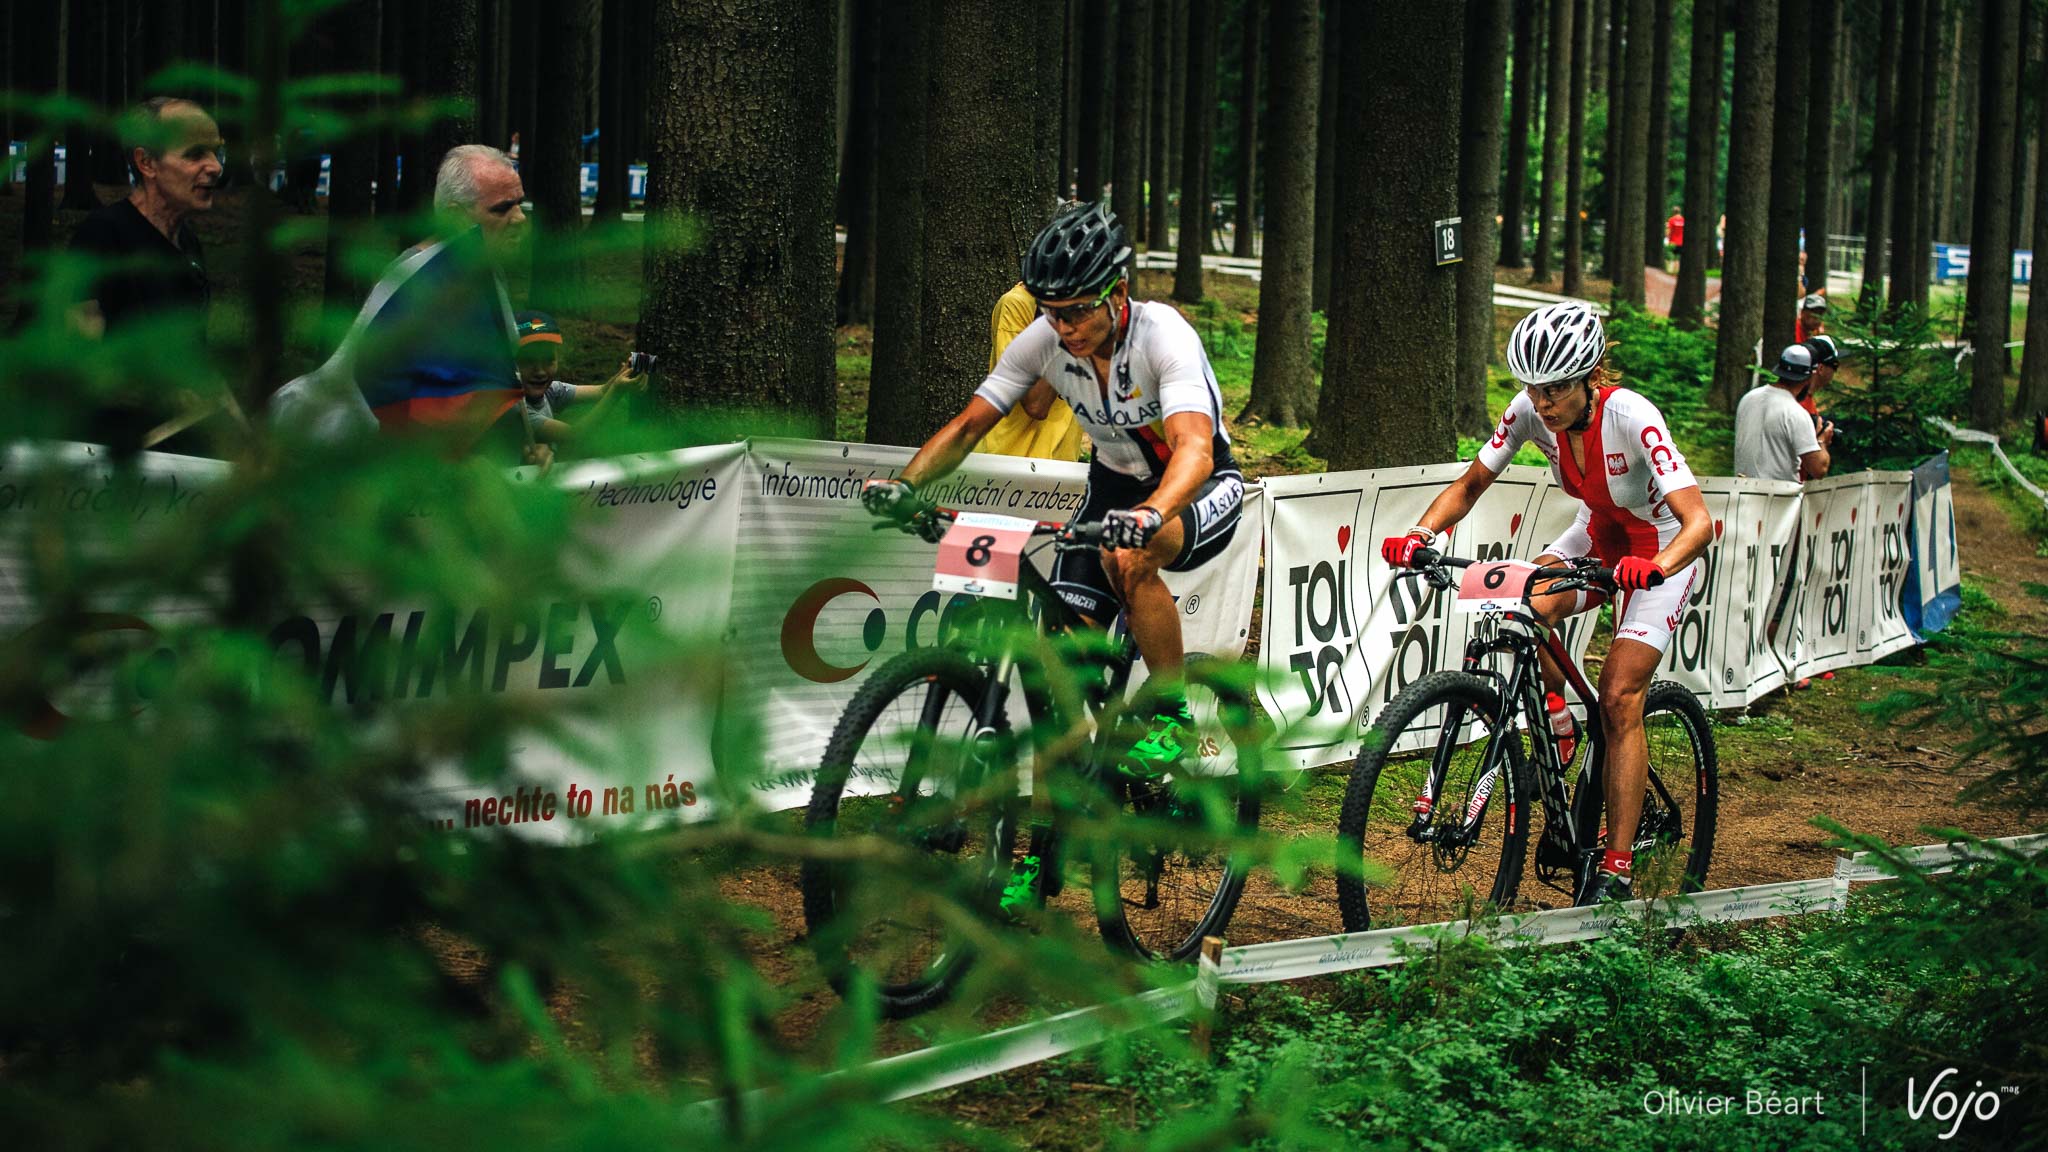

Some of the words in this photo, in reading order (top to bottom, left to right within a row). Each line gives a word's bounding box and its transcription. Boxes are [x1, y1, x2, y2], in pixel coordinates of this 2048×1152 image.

[1442, 227, 1455, 251] 18
[761, 461, 877, 500] informačn
[1008, 488, 1024, 509] a
[965, 534, 997, 568] 8
[1483, 564, 1511, 591] 6
[464, 786, 557, 829] nechte
[566, 783, 593, 819] to
[602, 785, 634, 816] na
[645, 774, 697, 812] nás
